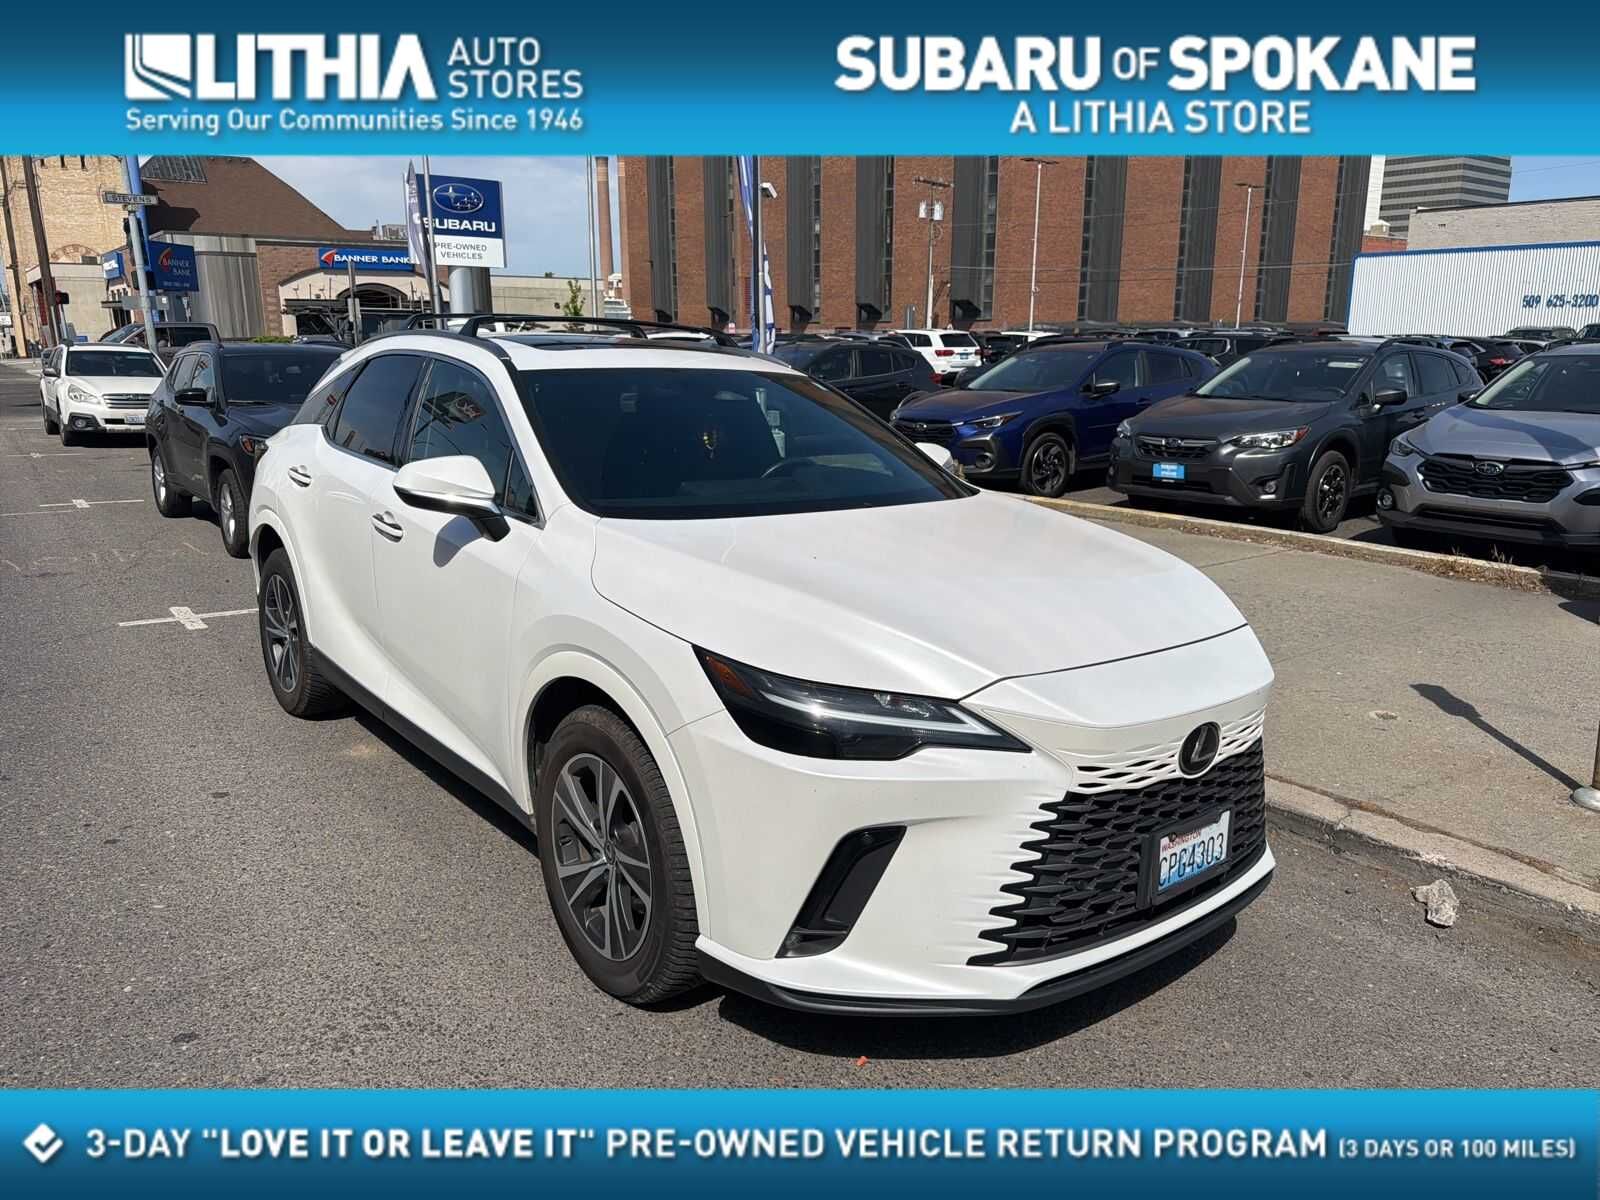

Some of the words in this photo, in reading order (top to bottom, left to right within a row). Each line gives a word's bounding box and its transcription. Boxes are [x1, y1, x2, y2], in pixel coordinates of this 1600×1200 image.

[424, 218, 496, 232] SUBARU
[435, 242, 487, 252] PRE-OWNED
[334, 254, 378, 263] BANNER
[381, 256, 410, 264] BANK
[441, 251, 483, 260] VEHICLES
[1522, 294, 1542, 309] 509
[1546, 294, 1600, 309] 625-3200
[1158, 832, 1224, 887] CPG4303
